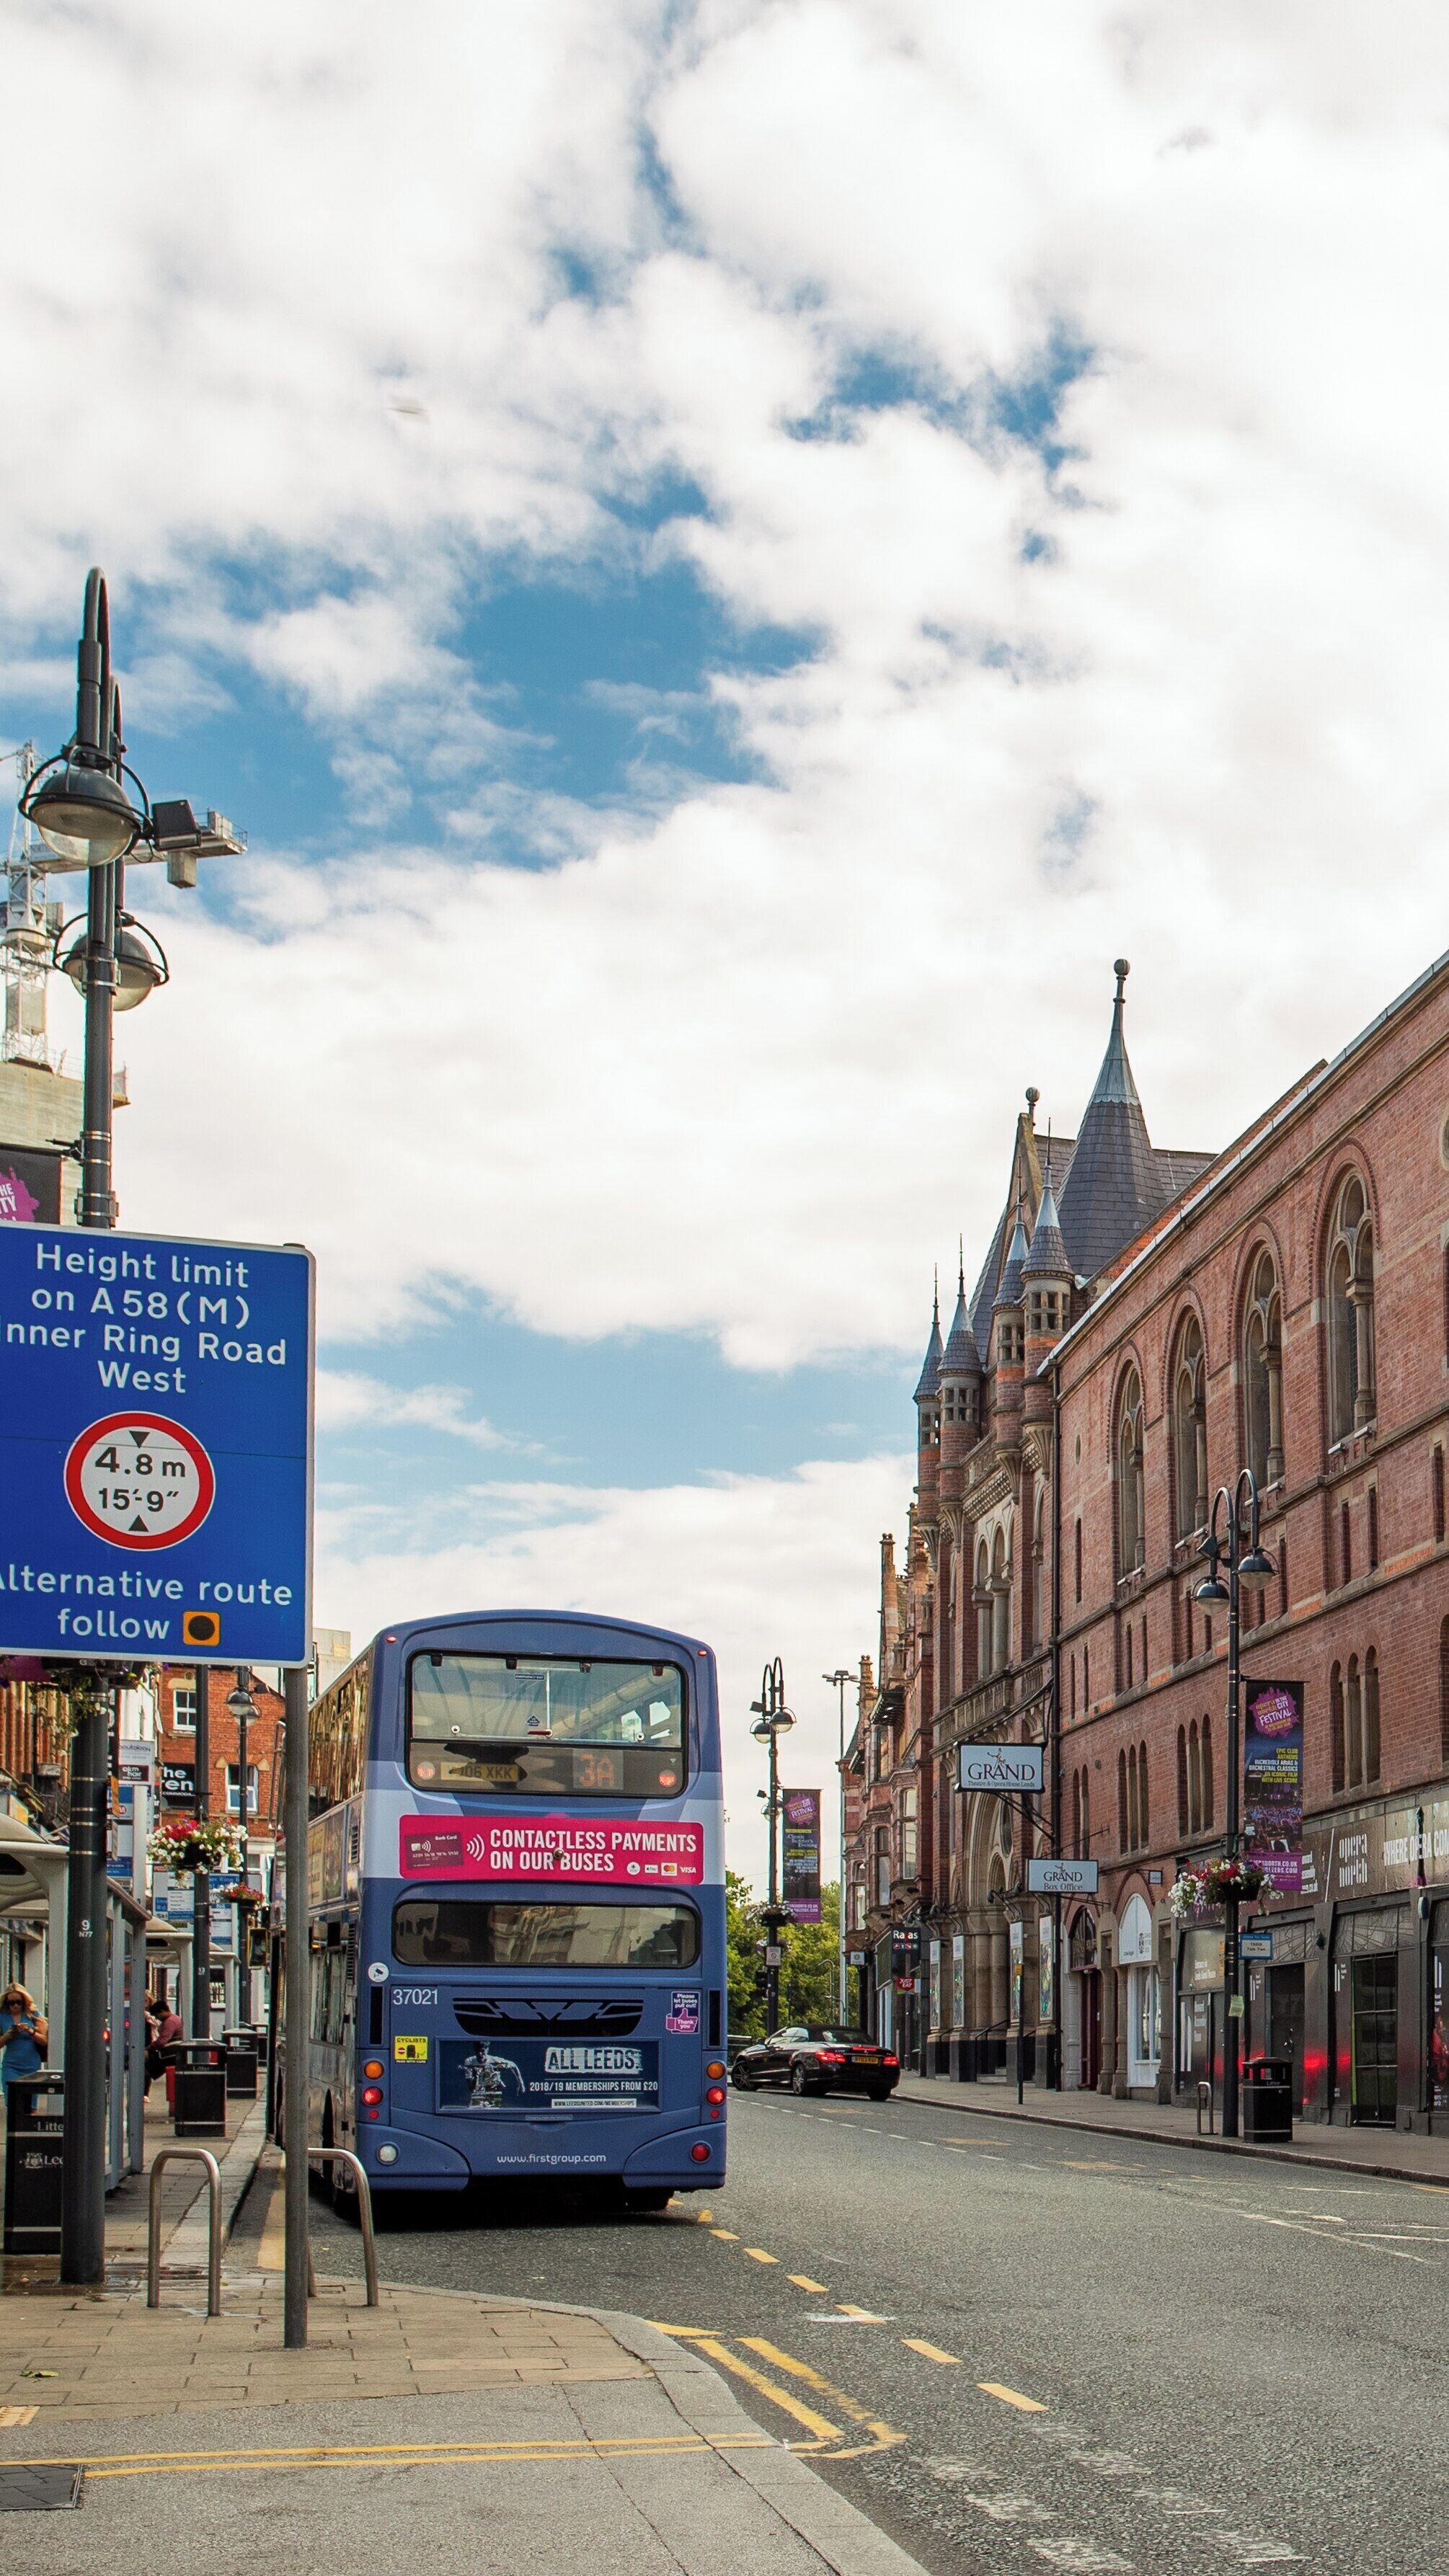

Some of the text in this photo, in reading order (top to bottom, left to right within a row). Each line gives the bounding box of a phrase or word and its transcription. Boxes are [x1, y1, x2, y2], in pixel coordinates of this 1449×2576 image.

[0, 1183, 14, 1196] HE
[0, 1195, 17, 1214] TY
[37, 1243, 249, 1288] Height limit
[32, 1288, 74, 1311] on
[0, 1319, 286, 1365] nner Ring Road
[98, 1360, 186, 1393] West
[199, 1578, 292, 1606] route
[58, 1607, 170, 1639] follow
[1277, 1700, 1289, 1710] CITY
[1259, 1709, 1292, 1727] FESTIVAL
[579, 1754, 616, 1787] 3A
[967, 1762, 1035, 1781] GRAND
[489, 1829, 697, 1852] CONTACTLESS PAYMENTS
[1339, 1834, 1368, 1863] opera
[489, 1850, 614, 1871] ON OUR BUSES
[1383, 1837, 1408, 1866] WHERE
[1043, 1871, 1083, 1882] GRAND
[1339, 1858, 1368, 1888] north
[1060, 1883, 1083, 1891] Office
[81, 1919, 90, 1931] 9
[393, 1989, 438, 2005] 37021
[549, 2050, 579, 2069] ALL
[530, 2081, 657, 2091] 2018/19 MEMBERSHIPS FROM £20
[37, 2121, 63, 2131] Litte
[497, 2154, 606, 2164] www.firstgroup.com
